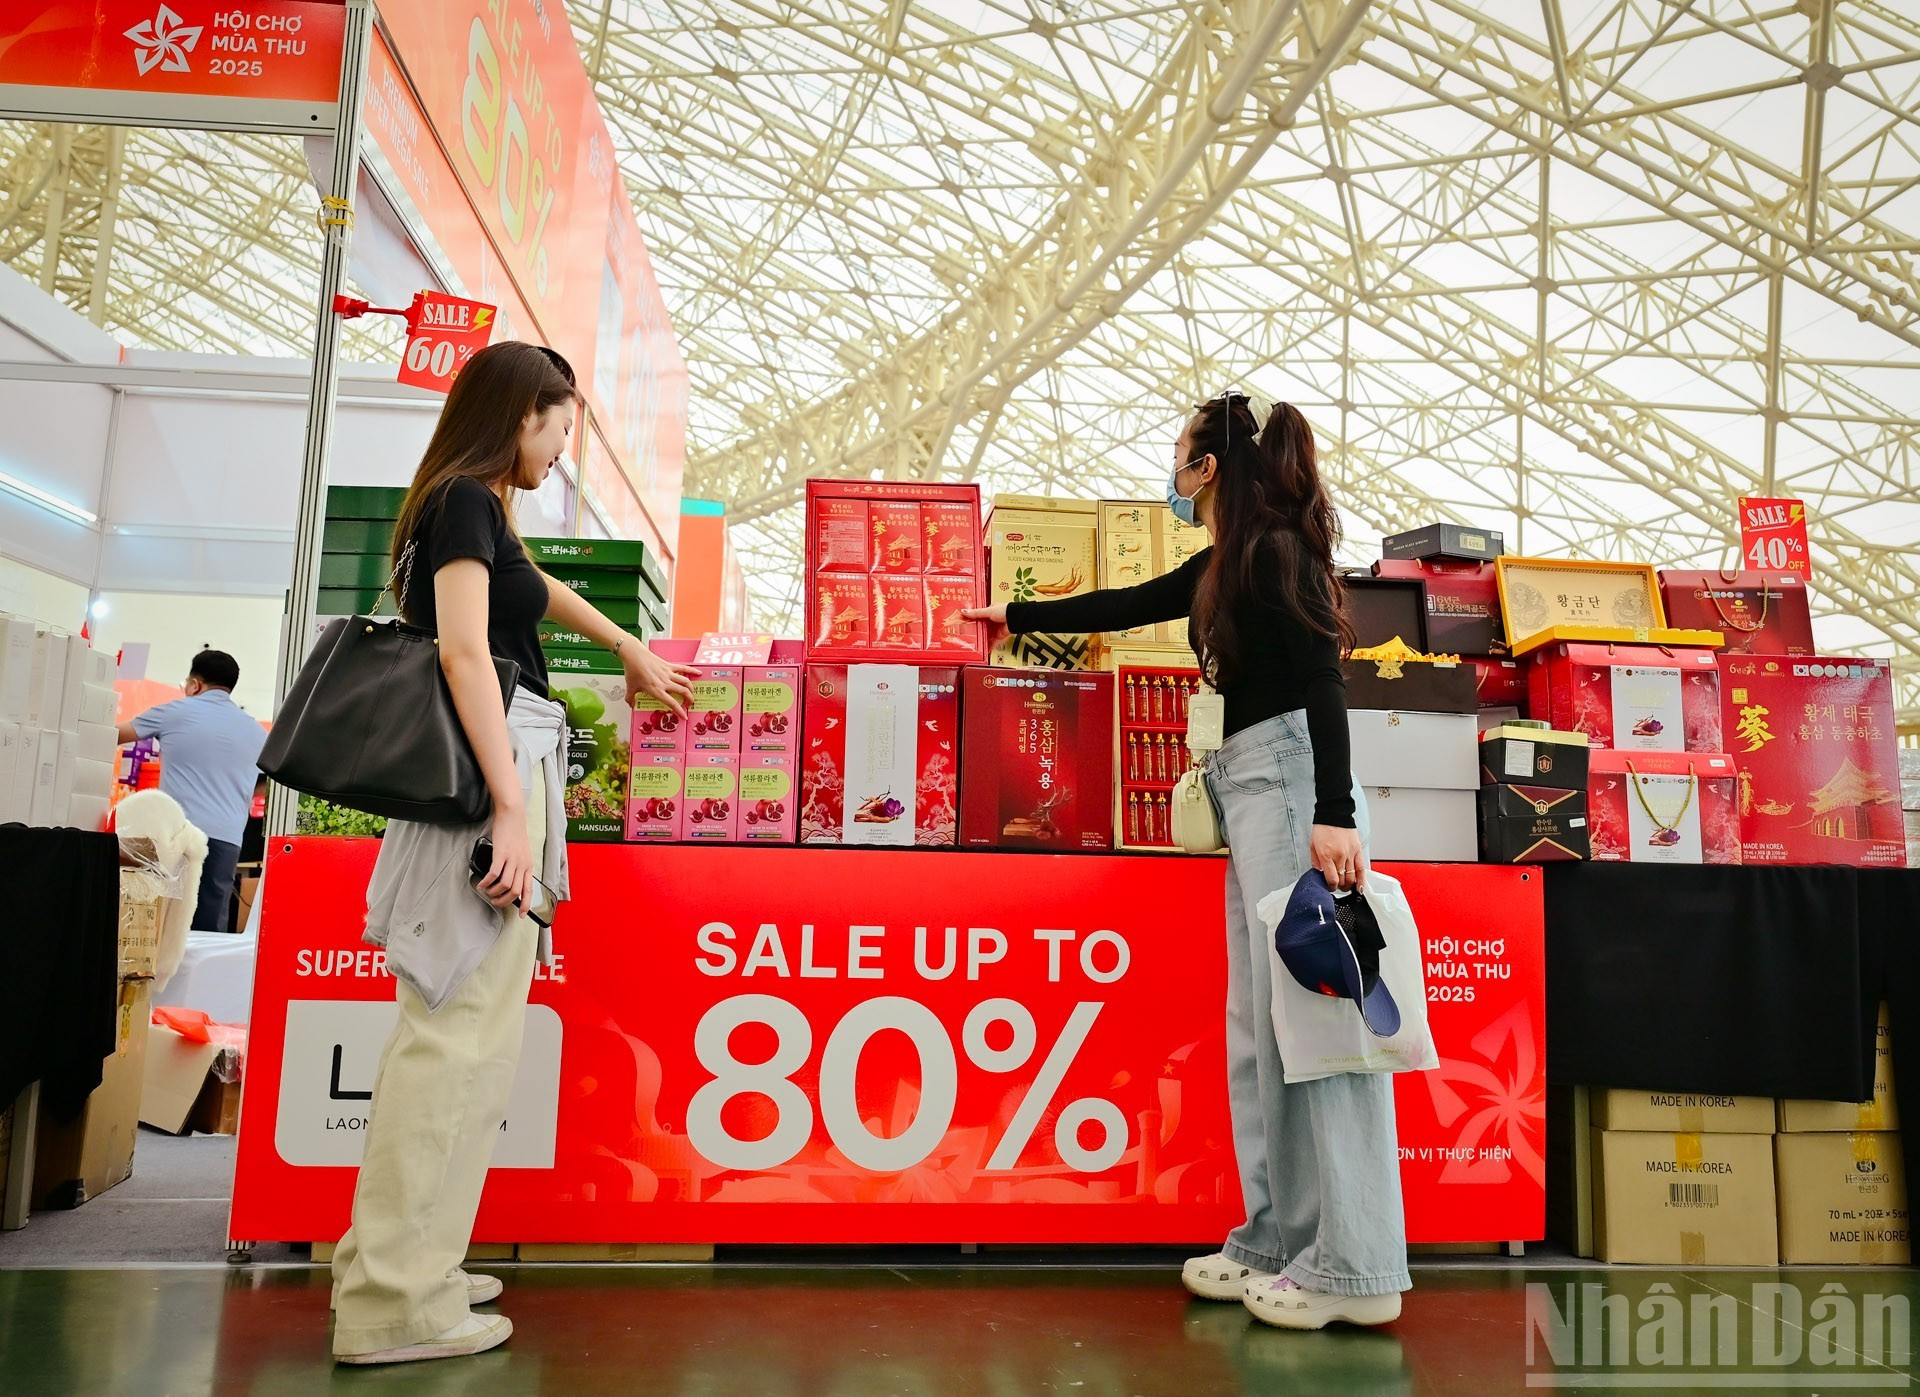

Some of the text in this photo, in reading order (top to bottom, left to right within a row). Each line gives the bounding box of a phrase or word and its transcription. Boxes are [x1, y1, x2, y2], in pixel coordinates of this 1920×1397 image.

[214, 10, 302, 34] HỘI CHỢ
[264, 38, 306, 56] THU
[209, 58, 263, 77] 2025
[522, 49, 544, 120] UP
[365, 74, 389, 131] UPER
[383, 66, 419, 149] PREMIUM
[461, 15, 555, 299] 80%
[423, 302, 470, 327] SALE
[1746, 504, 1788, 527] SALE
[1748, 536, 1803, 570] 40%
[1787, 560, 1805, 570] OFF
[1557, 593, 1601, 609] 황금단
[710, 635, 752, 647] SALE
[1803, 703, 1874, 724] 황제 태극
[1798, 725, 1884, 742] 홍삼 동충하초
[578, 824, 620, 832] HANSUSAM
[695, 922, 1130, 984] SALE UP TO
[1426, 935, 1505, 959] HỘI CHỢ
[296, 949, 564, 981] SUPER LE
[1473, 963, 1511, 979] THU
[1427, 985, 1475, 1003] 2025
[686, 994, 1130, 1172] 80%
[1650, 1095, 1736, 1108] MADE IN KOREA
[1419, 1148, 1433, 1162] VỊ
[1436, 1147, 1475, 1163] THỰC
[1479, 1145, 1512, 1163] HIỆN
[1646, 1161, 1733, 1174] MADE IN KOREA
[1829, 1210, 1840, 1219] 70
[1842, 1210, 1857, 1219] mL
[1829, 1231, 1861, 1242] MADE
[1863, 1231, 1875, 1242] IN
